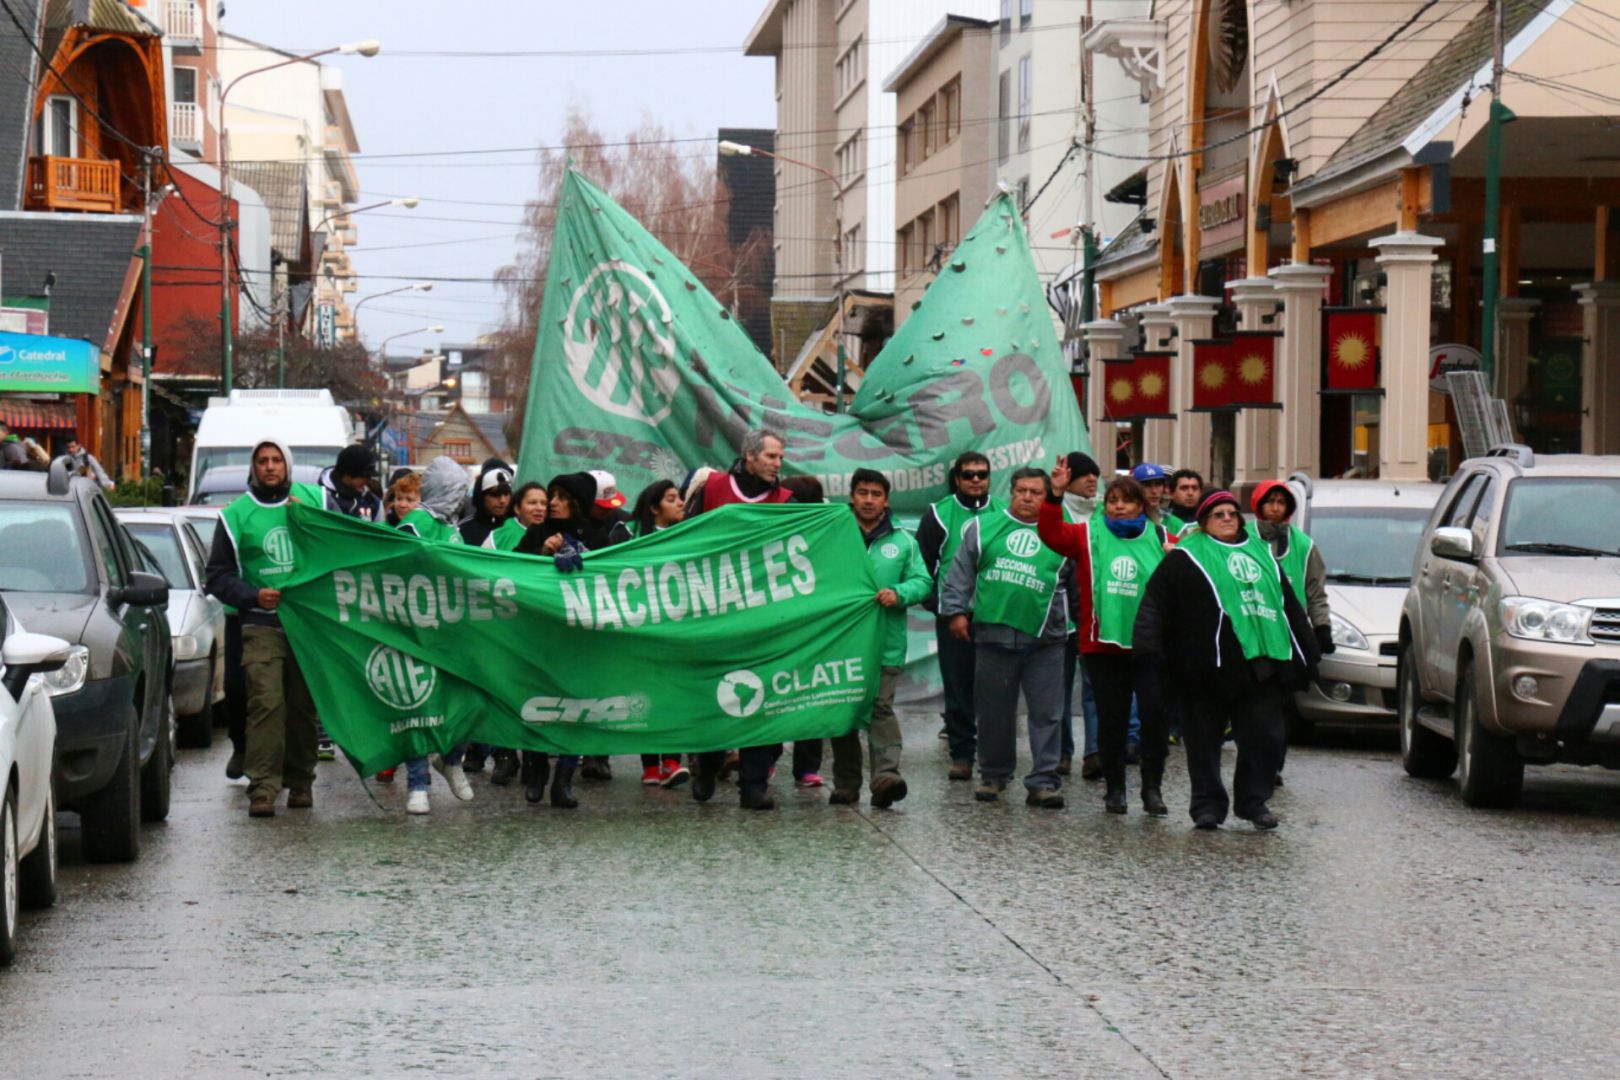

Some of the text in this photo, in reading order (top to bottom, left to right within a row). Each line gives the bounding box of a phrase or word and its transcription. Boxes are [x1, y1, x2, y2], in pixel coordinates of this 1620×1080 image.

[18, 349, 66, 361] Catedral
[995, 557, 1037, 576] SECCIONAL
[333, 534, 816, 631] PARQUES NACIONALES
[1001, 571, 1025, 585] VALLE
[1025, 577, 1046, 593] ESTE
[369, 645, 432, 706] ATE
[772, 657, 865, 695] CLATE
